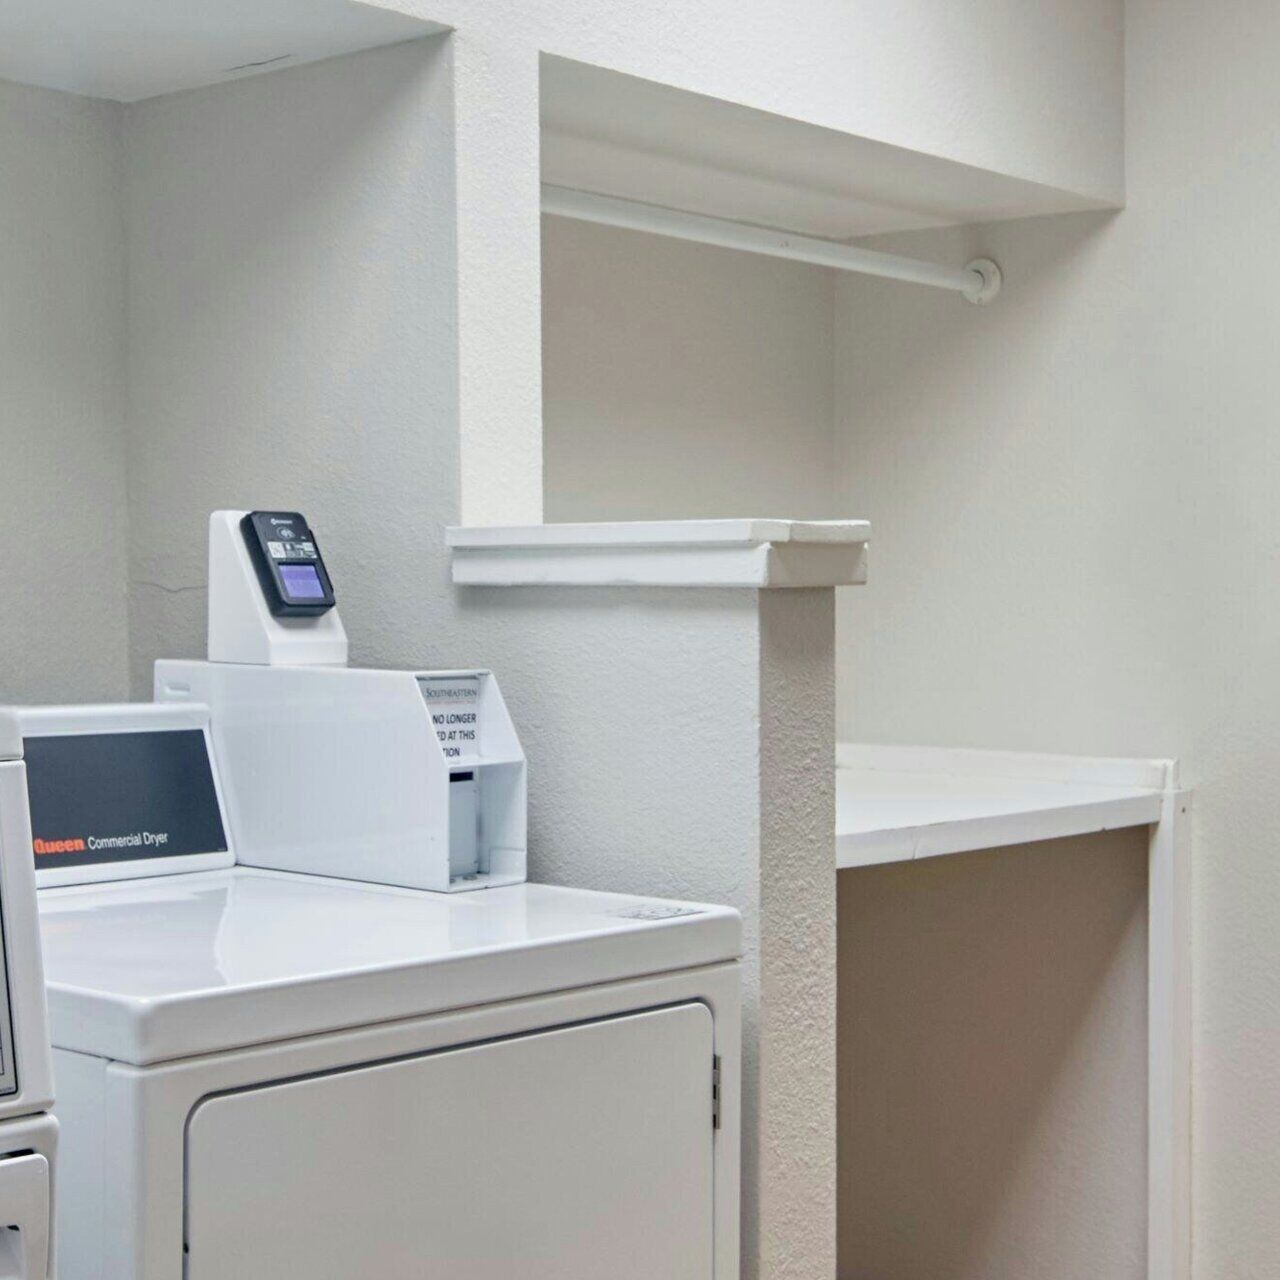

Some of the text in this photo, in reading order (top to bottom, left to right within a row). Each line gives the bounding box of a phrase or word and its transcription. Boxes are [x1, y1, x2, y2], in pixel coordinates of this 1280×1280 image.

[433, 714, 476, 724] NO LONGER
[448, 731, 456, 740] AT
[459, 730, 475, 740] THIS
[34, 832, 168, 854] Queen Commercial Dryer
